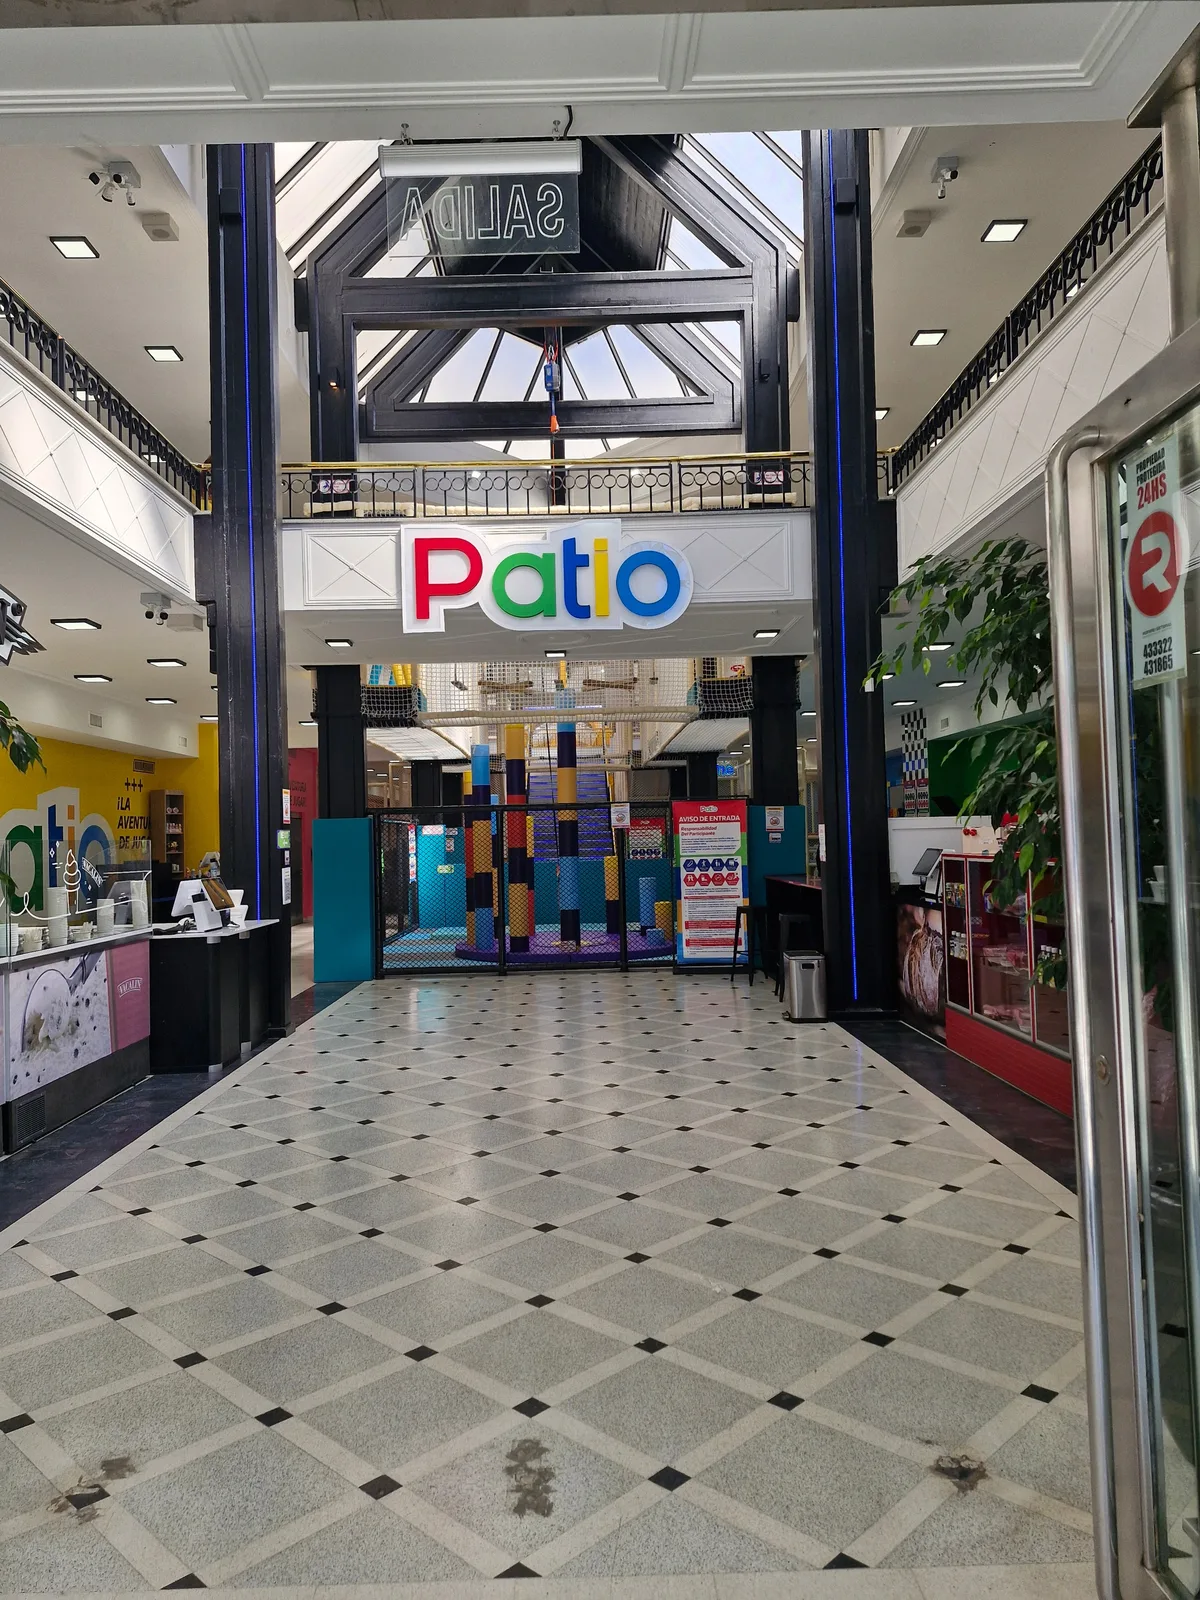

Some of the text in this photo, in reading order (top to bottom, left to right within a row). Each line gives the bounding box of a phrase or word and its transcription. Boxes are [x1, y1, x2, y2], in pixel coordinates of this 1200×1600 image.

[1135, 447, 1166, 474] PROPIEDAD
[1136, 460, 1166, 486] PROTEGIDA
[1137, 472, 1167, 510] 24HS
[414, 537, 681, 620] Patio
[1143, 636, 1173, 659] 433322
[1143, 654, 1174, 676] 431865
[5, 804, 112, 914] atio
